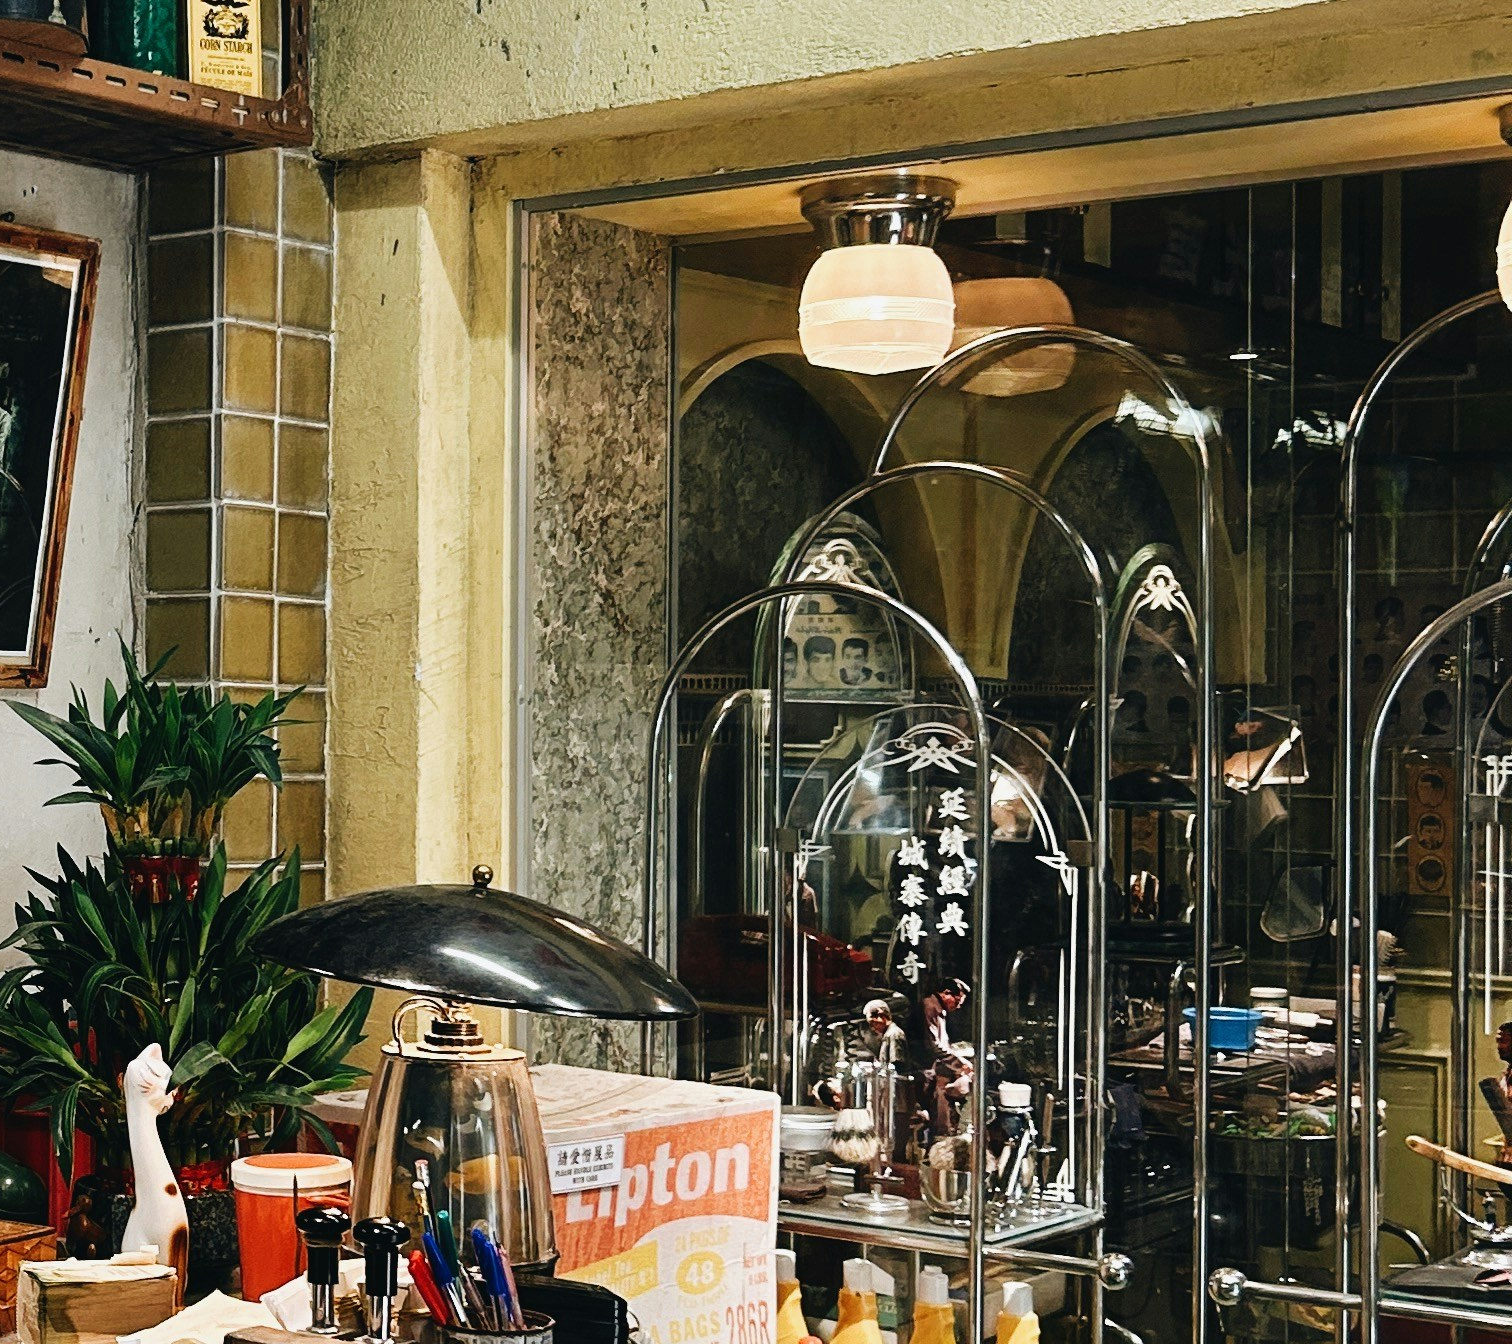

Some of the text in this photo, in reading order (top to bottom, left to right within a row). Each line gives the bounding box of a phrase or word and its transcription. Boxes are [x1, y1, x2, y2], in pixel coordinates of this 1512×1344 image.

[199, 39, 253, 54] CORN STARCH
[897, 835, 930, 985] 城寨傳奇
[684, 1260, 715, 1286] 48
[668, 1311, 721, 1344] BAGS
